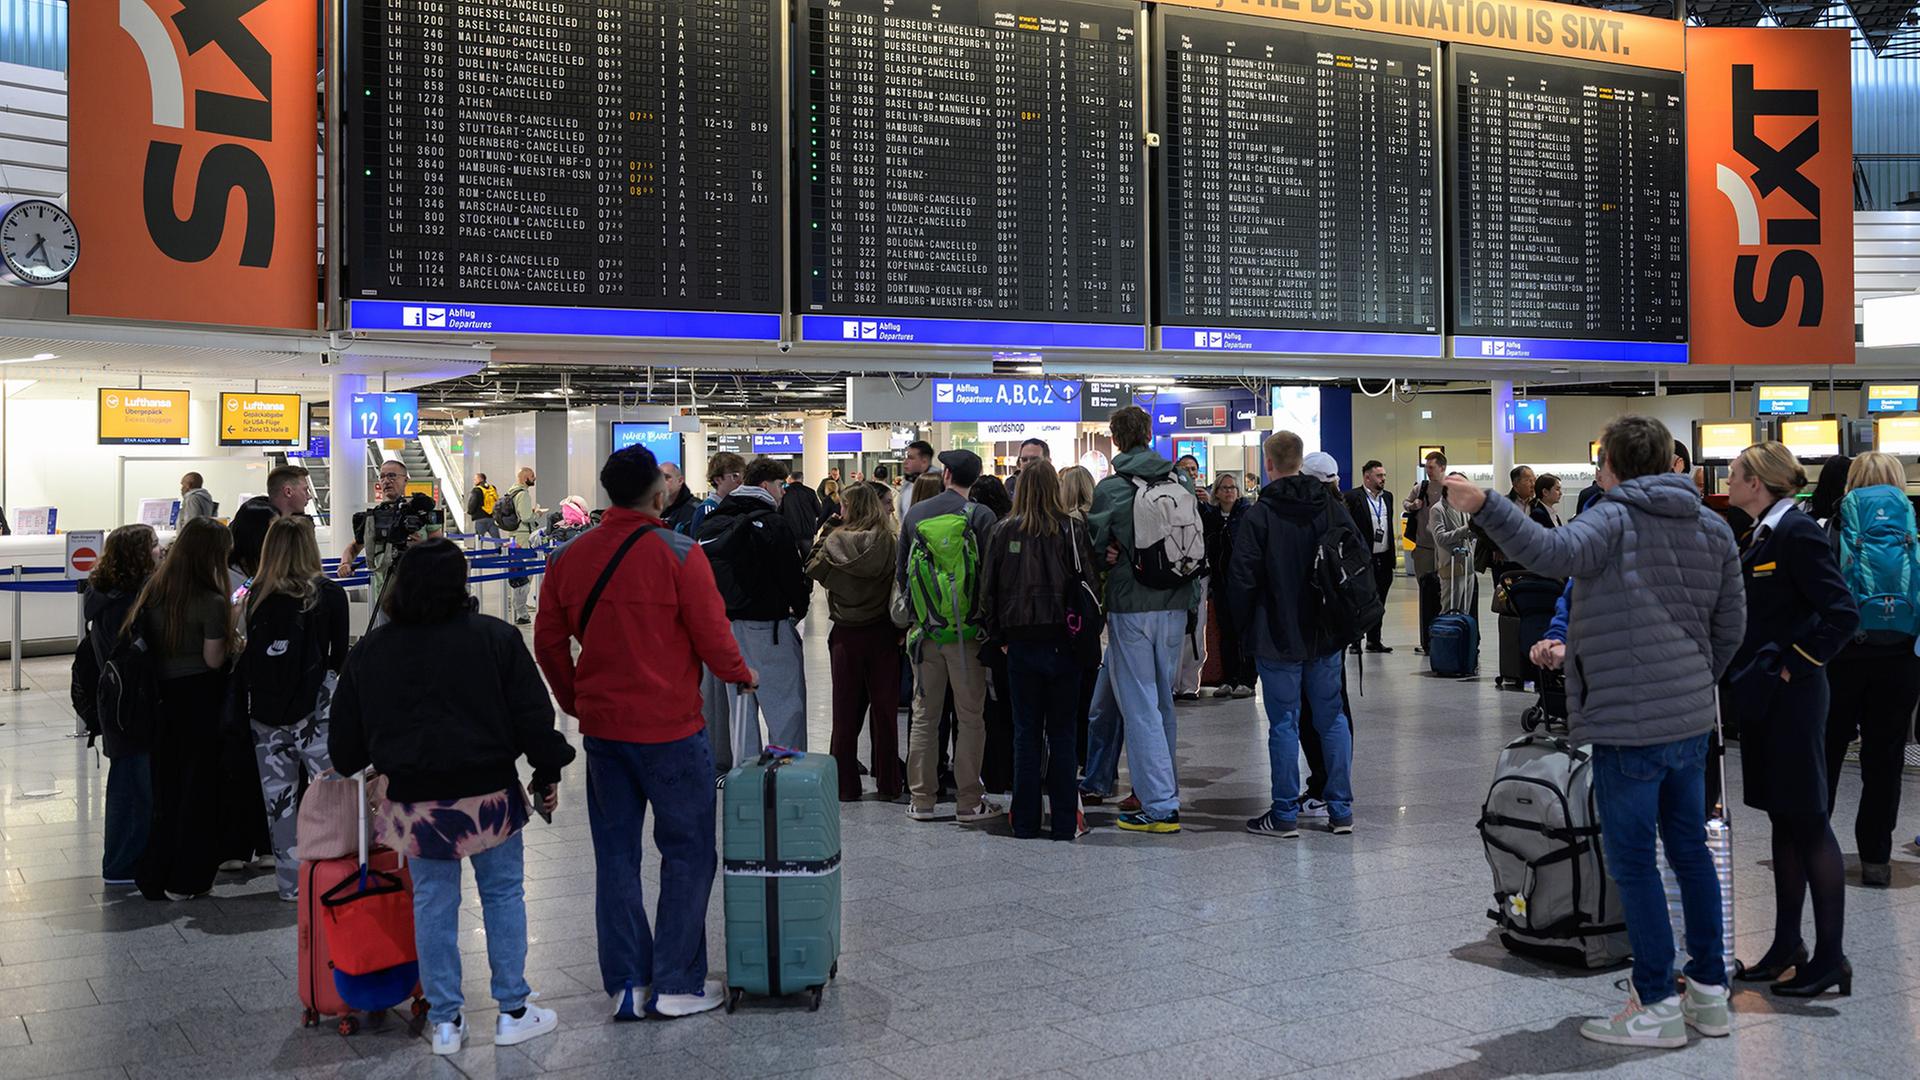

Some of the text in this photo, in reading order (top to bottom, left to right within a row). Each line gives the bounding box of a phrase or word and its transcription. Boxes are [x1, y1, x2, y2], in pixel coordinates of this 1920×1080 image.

[418, 1, 577, 28] 1004 BRUESSEL-CANCELLED
[418, 14, 558, 38] 1200 BASEL-CANCELLED
[1527, 8, 1553, 45] IS
[1561, 13, 1630, 56] SIXT.
[423, 27, 571, 52] 246 MAILAND-CANCELLED
[423, 40, 584, 66] 390 LUXEMBURG-CANCELLED
[884, 40, 964, 57] DUESSELDORF HBF
[424, 53, 564, 76] 976 DUBLIN-CANCELLED
[884, 52, 970, 69] BERLIN-CANCELLED
[423, 66, 564, 89] 050 BREMEN-CANCELLED
[885, 75, 923, 87] ZUERICH
[424, 80, 552, 100] 858 OSLO-CANCELLED
[885, 86, 986, 105] AMSTERDAM-CANCELLED
[418, 93, 767, 132] 1278 ATHEN B19
[885, 98, 991, 116] BASEL BAD-MANNHEIM-K
[424, 106, 578, 128] 040 HANNOVER-CANCELLED
[885, 109, 981, 126] BERLIN-BRANDENBURG
[143, 0, 275, 268] SIX
[425, 119, 584, 141] 130 STUTTGART-CANCELLED
[885, 121, 924, 133] HAMBURG
[425, 132, 584, 154] 140 NUERNBERG-CANCELLED
[885, 133, 950, 146] GRAN CANARIA
[417, 145, 591, 167] 3600 DORTMUND-KOELN HBF-D
[885, 144, 924, 156] ZUERICH
[417, 158, 590, 179] 3640 HAMBURG-MUENSTER-OSN
[886, 156, 908, 166] WIEN
[424, 172, 767, 203] 094 MUENCHEN A11
[886, 179, 908, 189] PISA
[424, 185, 546, 202] 230 ROM-CANCELLED
[886, 191, 977, 205] HAMBURG-CANCELLED
[1731, 64, 1824, 327] SIXT
[418, 198, 578, 217] 1346 WARSCHAU-CANCELLED
[886, 202, 972, 216] LONDON-CANCELLED
[424, 211, 585, 230] 800 STOCKHOLM-CANCELLED
[886, 214, 967, 227] NIZZA-CANCELLED
[419, 224, 552, 240] 1392 PRAG-CANCELLED
[886, 226, 924, 236] ANTALYA
[886, 237, 977, 251] BOLOGNA-CANCELLED
[418, 250, 559, 266] 1026 PARIS-CANCELLED
[886, 248, 977, 262] PALERMO-CANCELLED
[418, 264, 585, 280] 1124 BARCELONA-CANCELLED
[887, 260, 988, 273] KOPENHAGE-CANCELLED
[886, 272, 908, 281] GENF
[419, 277, 585, 293] 1124 BARCELONA-CANCELLED
[887, 283, 982, 296] DORTMUND-KOELN HBF
[887, 295, 993, 307] HAMBURG-MUENSTER-OSN
[449, 308, 476, 319] Abflug
[449, 319, 492, 329] Departures
[880, 322, 900, 332] Abflug
[880, 332, 914, 341] Departures
[1224, 332, 1242, 341] Abflug
[1224, 341, 1252, 350] Departures
[956, 384, 978, 394] Abflug
[125, 397, 172, 407] Lufthansa
[243, 400, 285, 410] Lufthansa
[956, 395, 992, 404] Departures
[361, 412, 378, 434] 12
[394, 412, 414, 434] 12
[1159, 414, 1177, 424] Change
[1528, 414, 1544, 430] 11
[988, 422, 1024, 434] worldshop
[783, 436, 790, 445] A
